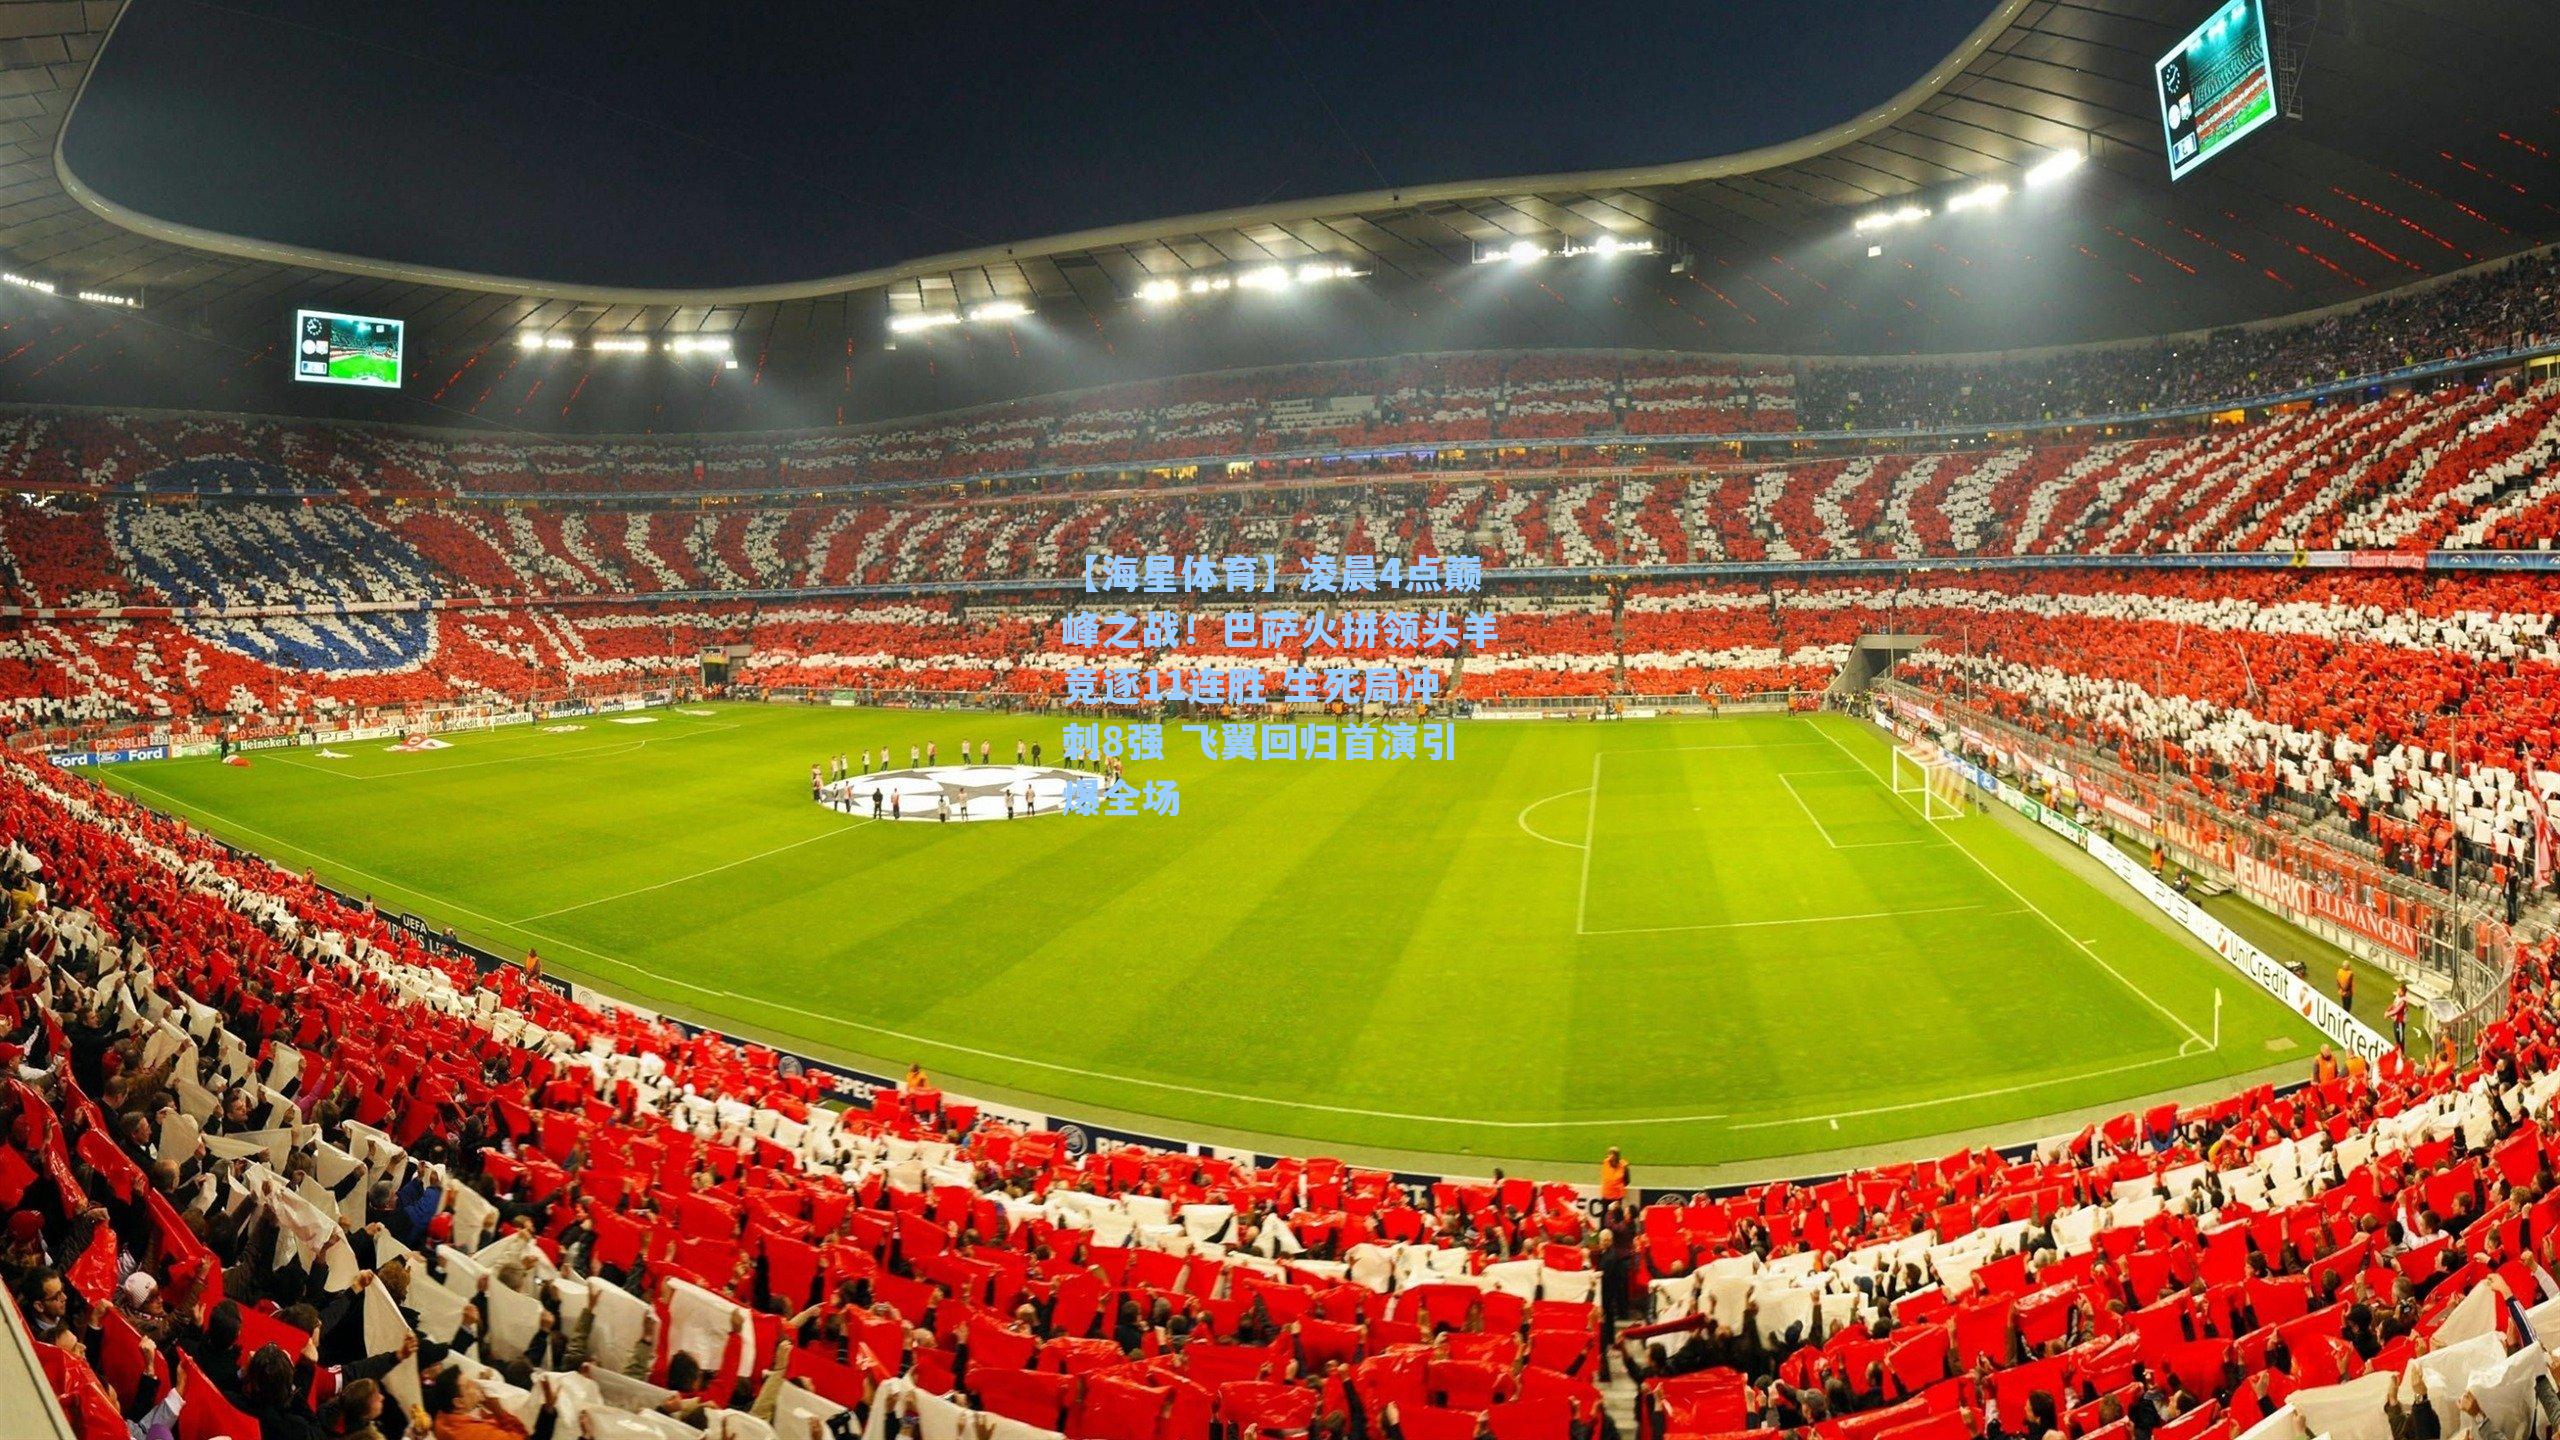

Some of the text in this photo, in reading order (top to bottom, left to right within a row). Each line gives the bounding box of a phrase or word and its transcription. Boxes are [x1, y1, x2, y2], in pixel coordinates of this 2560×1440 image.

[240, 738, 289, 750] Heineken
[52, 754, 88, 768] Ford
[129, 748, 163, 762] Ford
[2155, 881, 2189, 924] PS3
[403, 914, 428, 935] UEFA
[2316, 889, 2415, 950] ELLWANGEN
[2231, 935, 2289, 1001] UniCredit
